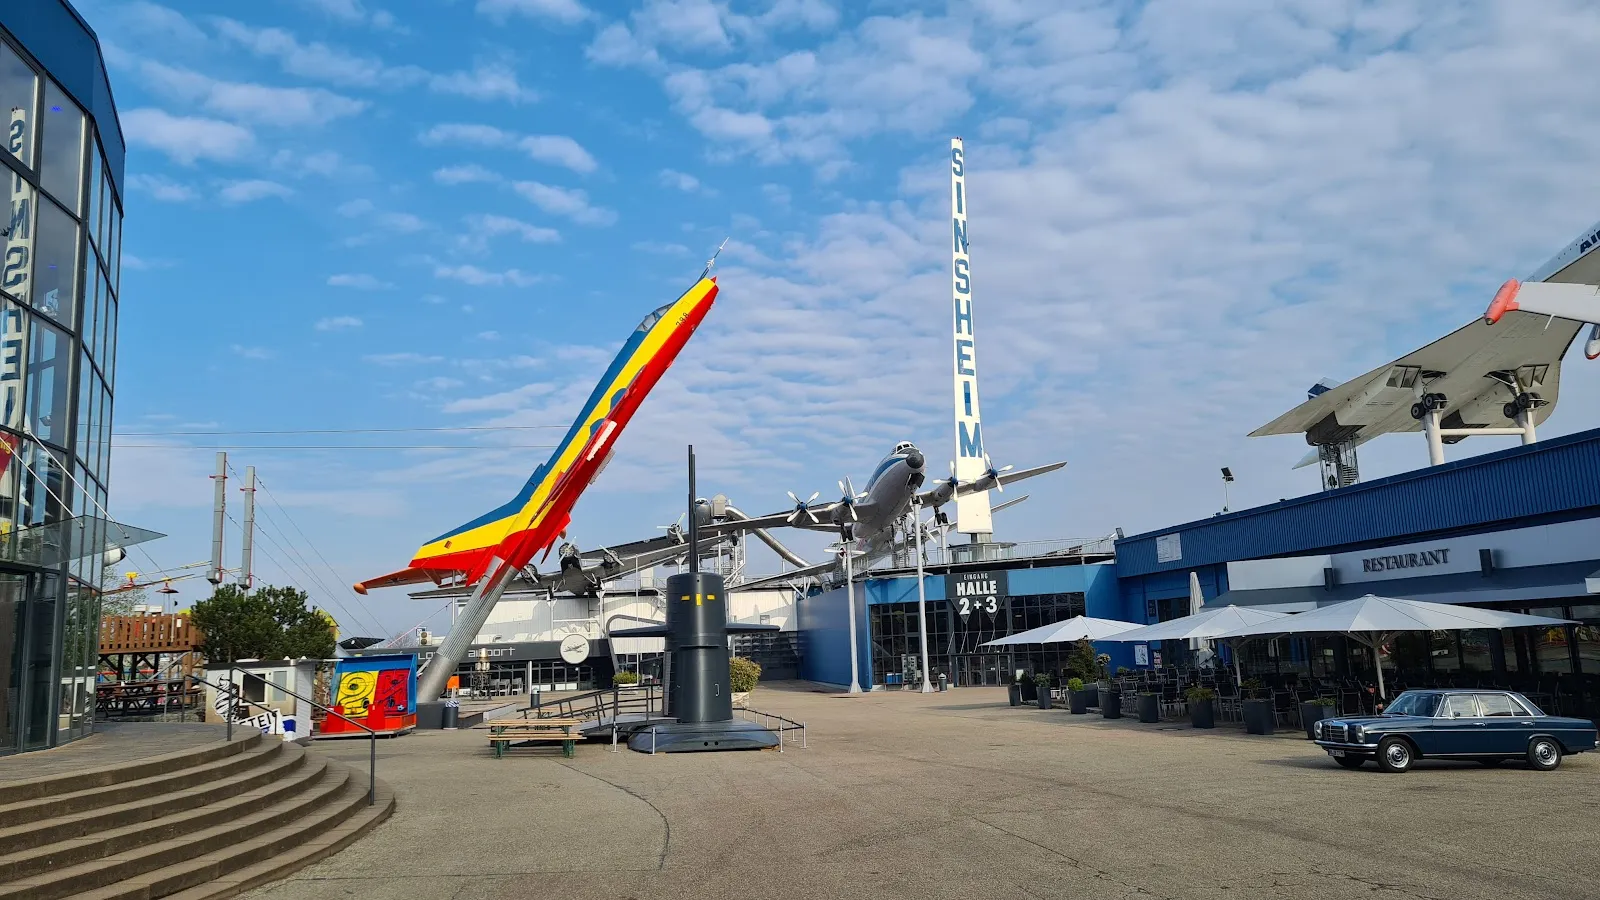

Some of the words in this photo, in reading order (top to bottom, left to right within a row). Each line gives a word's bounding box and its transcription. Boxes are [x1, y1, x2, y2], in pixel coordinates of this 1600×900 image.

[951, 147, 983, 459] SINSHEIM
[1362, 548, 1450, 572] RESTAURANT
[963, 572, 989, 580] EINGANG
[956, 580, 997, 596] HALLE
